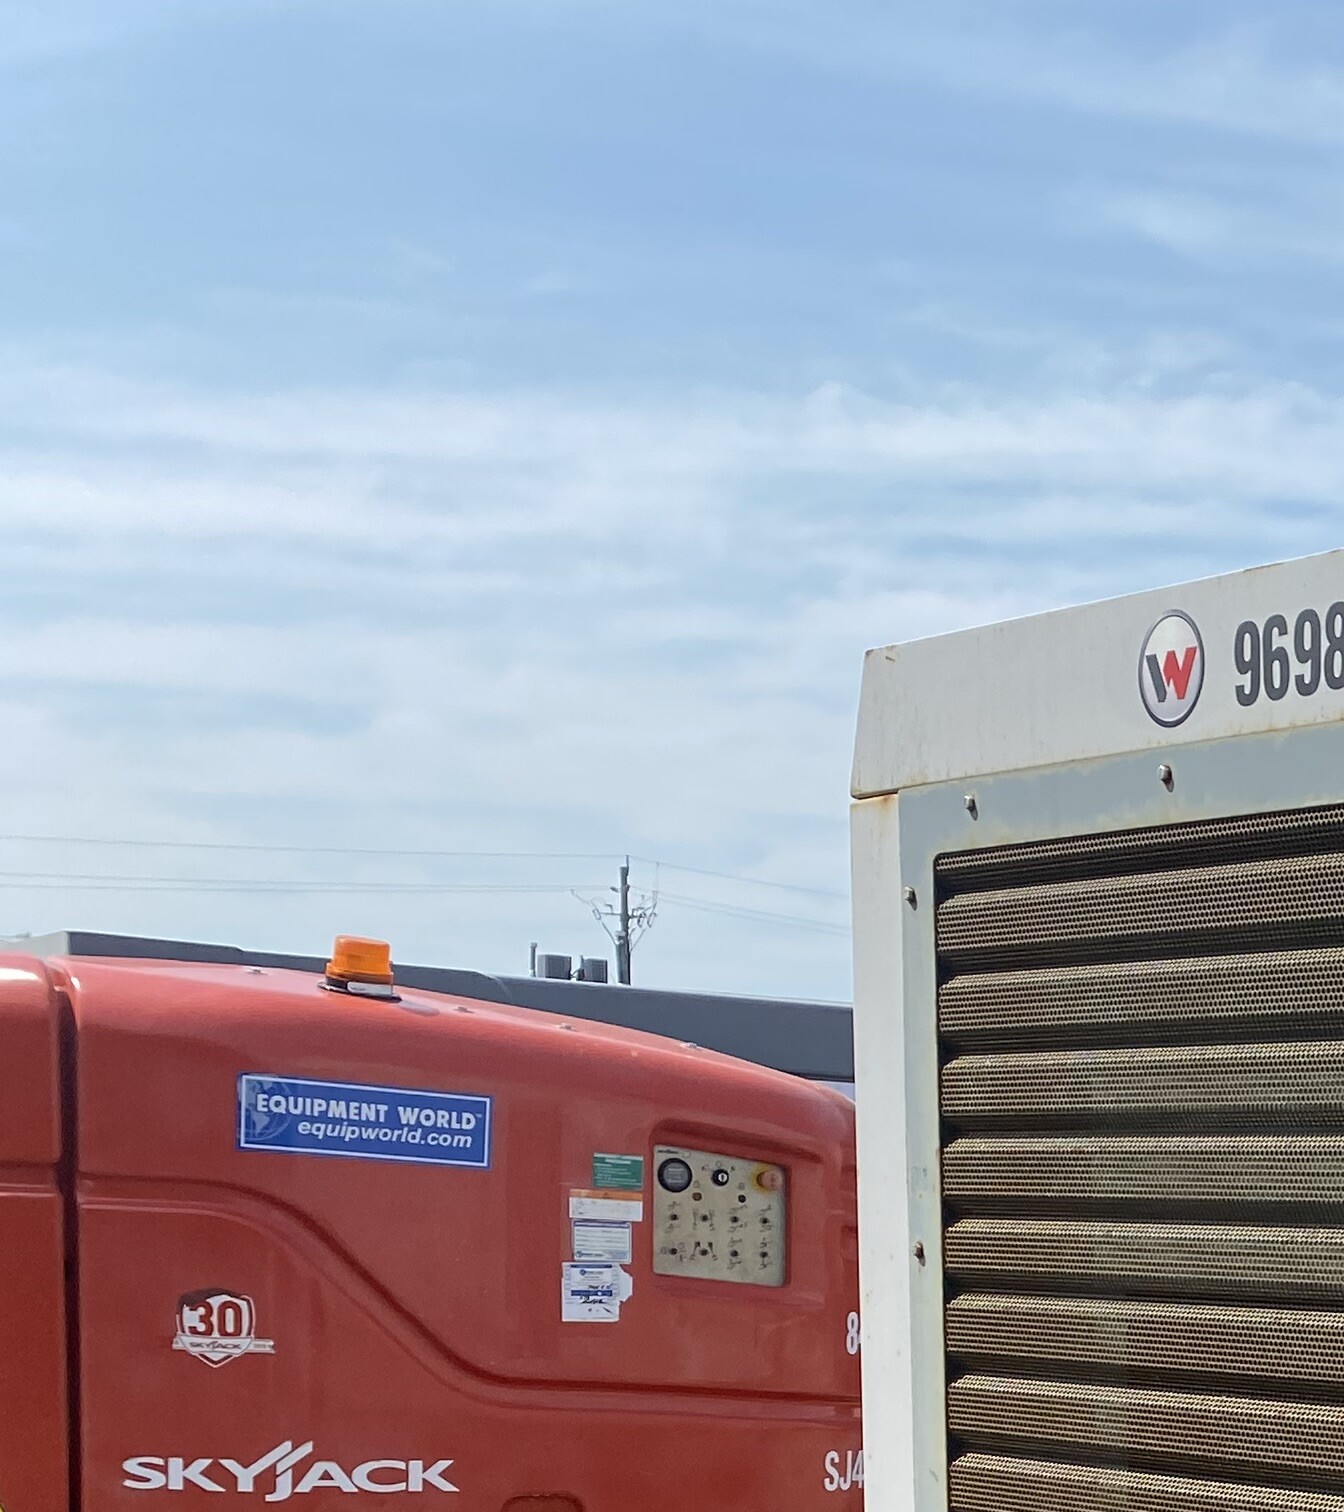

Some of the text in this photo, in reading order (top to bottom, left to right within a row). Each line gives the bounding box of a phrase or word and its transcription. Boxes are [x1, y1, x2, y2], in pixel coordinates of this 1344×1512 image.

[256, 1094, 477, 1130] EQUIPMENT WORLD
[297, 1121, 473, 1148] equipworld.com
[188, 1300, 242, 1337] 30
[845, 1311, 862, 1355] 8
[122, 1440, 460, 1502] SKYJACK
